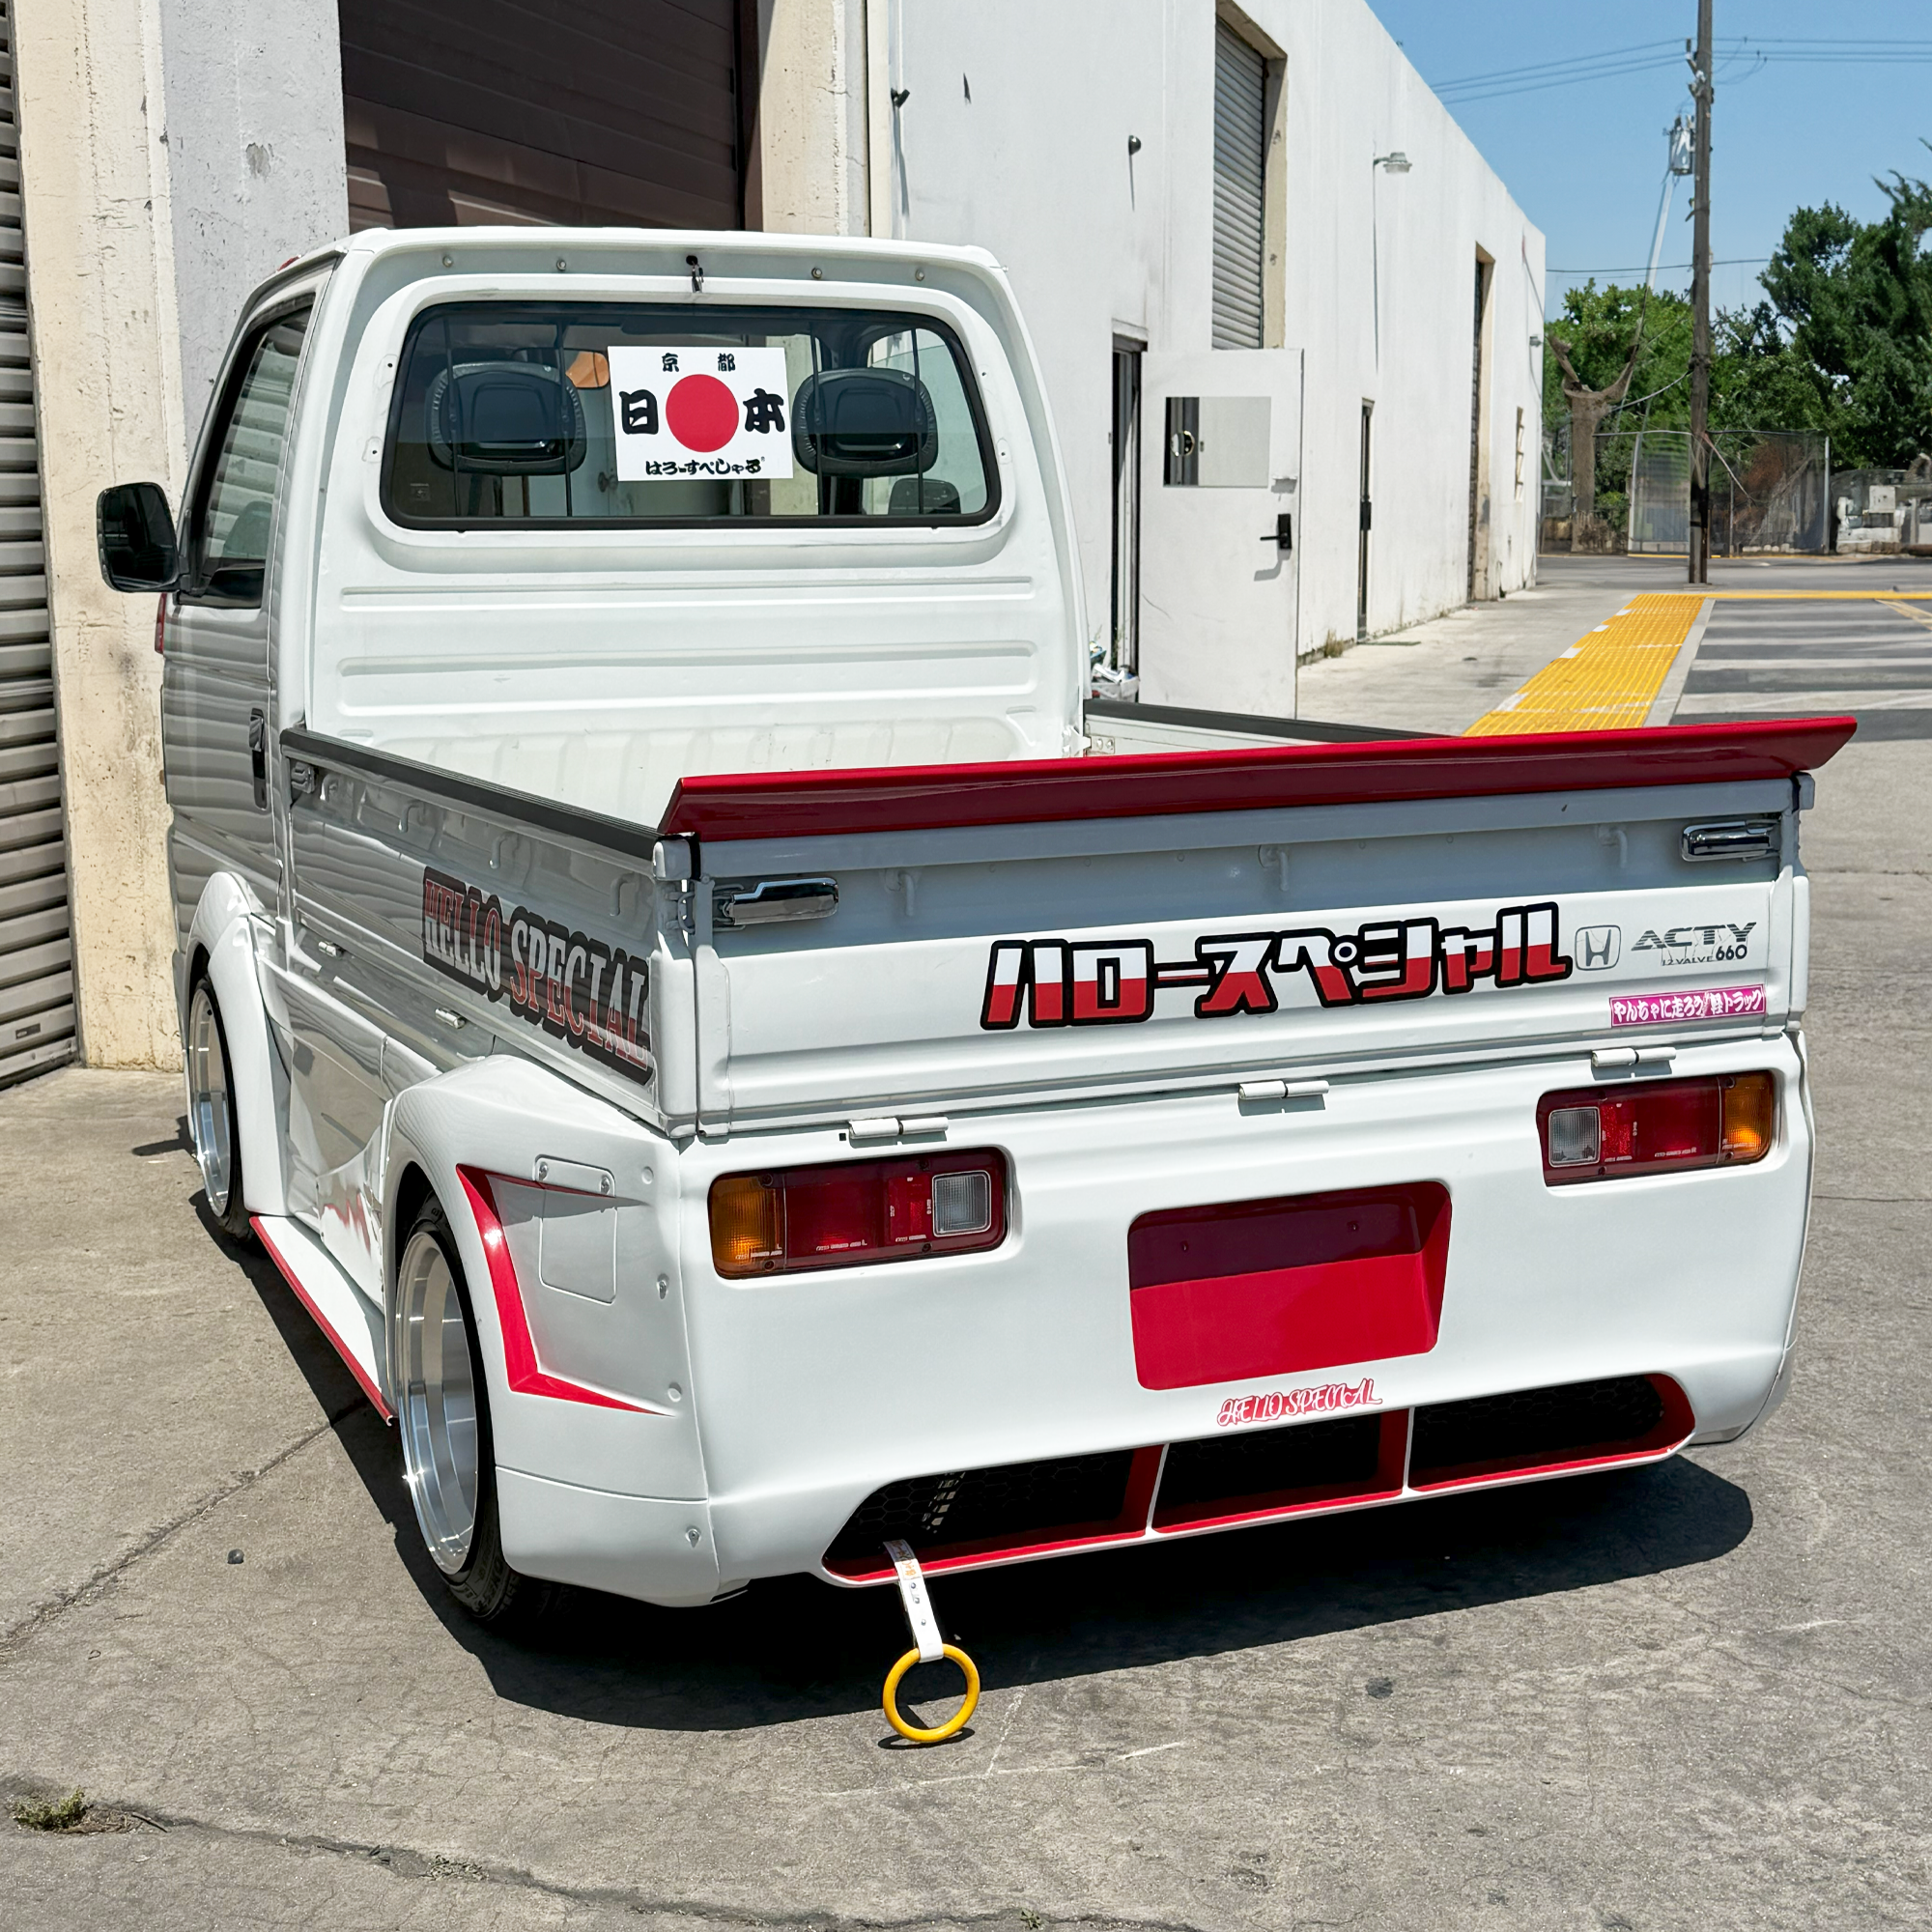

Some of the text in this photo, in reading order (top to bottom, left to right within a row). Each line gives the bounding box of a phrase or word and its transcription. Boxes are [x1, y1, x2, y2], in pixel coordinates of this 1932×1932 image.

[1631, 922, 1757, 952] ACTY
[1715, 944, 1747, 961] 660
[424, 877, 648, 1072] HELLO SPECIAL
[980, 901, 1574, 1031] ハロースペシャル
[1217, 1391, 1283, 1426] HELLO
